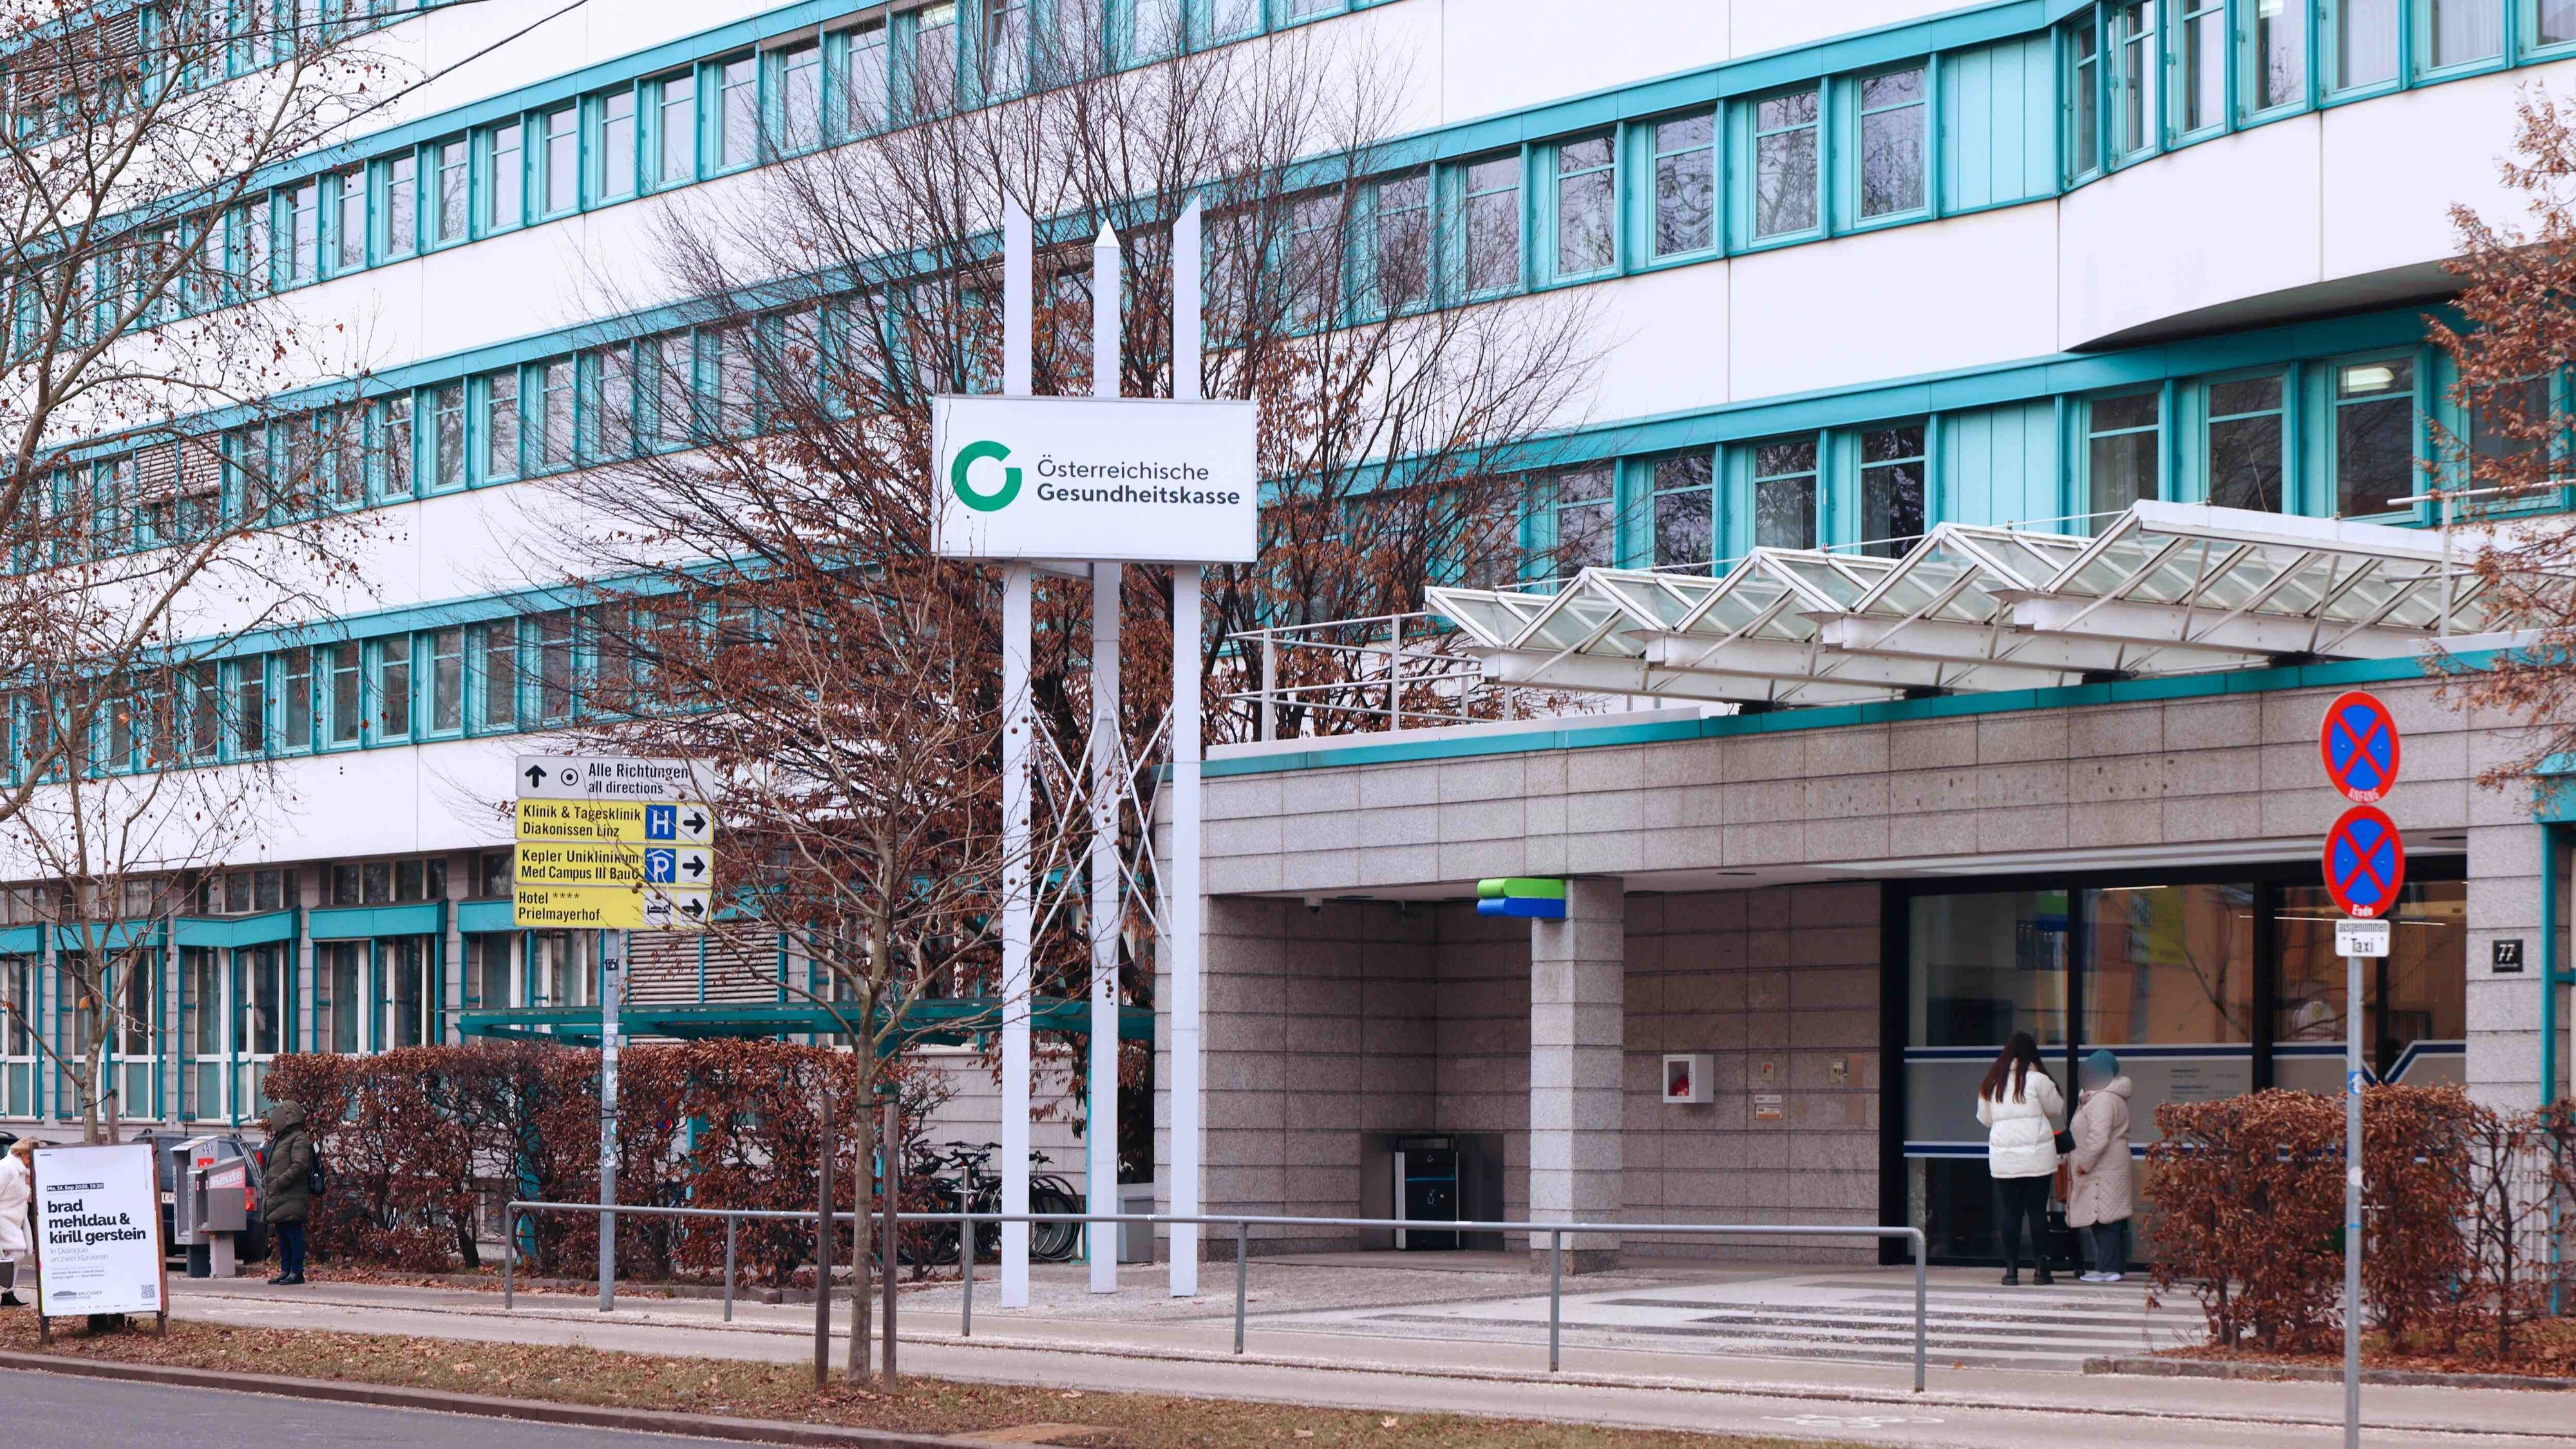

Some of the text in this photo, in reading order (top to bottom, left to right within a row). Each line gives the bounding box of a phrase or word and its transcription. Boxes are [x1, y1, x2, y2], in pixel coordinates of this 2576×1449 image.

[1037, 455, 1209, 480] Österreichische
[1037, 483, 1240, 504] Gesundheitskasse
[589, 763, 688, 781] Alle Richtungen
[589, 781, 663, 794] all directions
[524, 804, 641, 822] Klinik & Tagesklinik
[524, 822, 620, 837] Diakonissen Linz
[522, 849, 639, 864] Kepler Uniklinikum
[521, 866, 546, 878] Med
[549, 867, 592, 882] Campus
[595, 867, 606, 879] III
[518, 892, 548, 904] Hotel
[518, 908, 600, 923] Prielmayerhof
[2351, 904, 2374, 917] Ende
[2338, 923, 2387, 934] ausgenommen
[2351, 938, 2374, 952] Taxi
[2498, 943, 2515, 961] 77
[48, 1199, 83, 1213] brad
[49, 1213, 131, 1228] mehldau &
[50, 1227, 146, 1245] kirill gerstein
